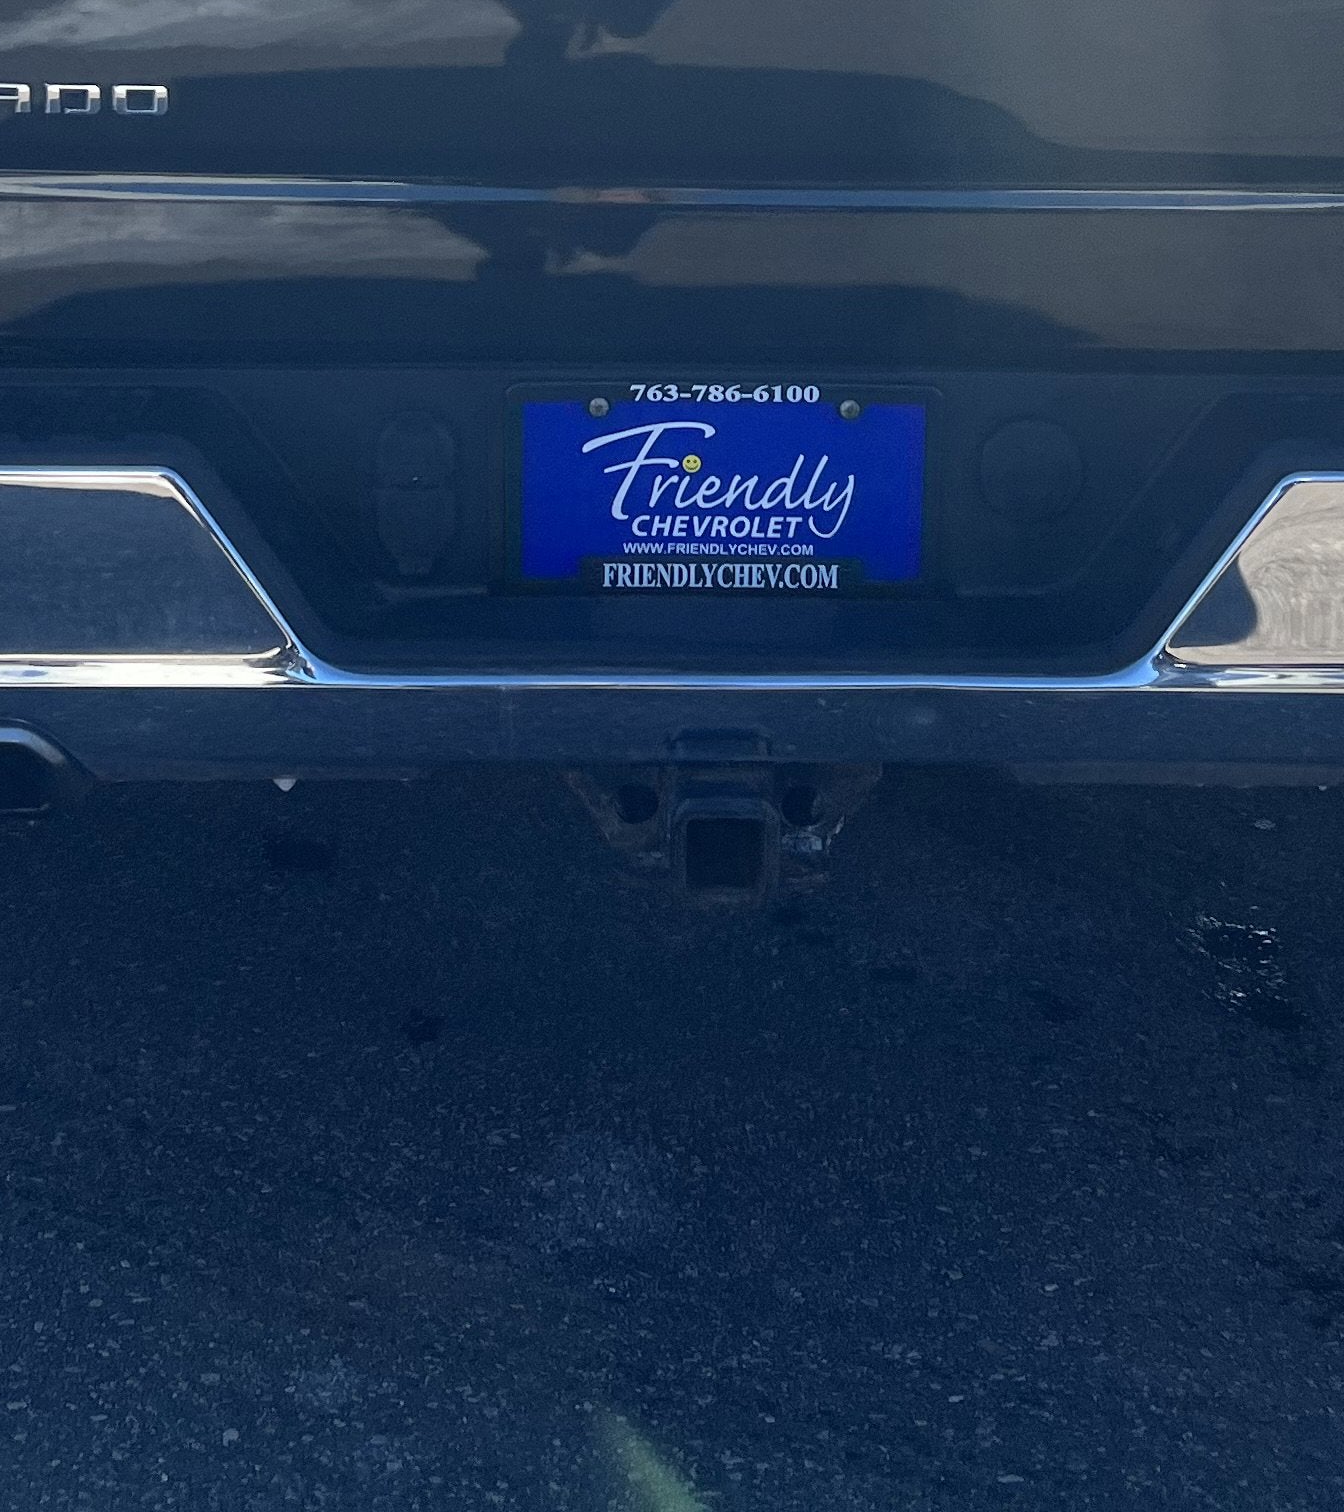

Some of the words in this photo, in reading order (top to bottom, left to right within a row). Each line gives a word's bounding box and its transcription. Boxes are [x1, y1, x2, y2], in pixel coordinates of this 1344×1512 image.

[629, 383, 820, 403] 763-786-6100
[581, 420, 855, 539] Friendly
[631, 514, 803, 539] CHEVROLET
[623, 541, 814, 557] WWW.FRIENDLYCHEV.COM
[602, 562, 839, 589] FRIENDLYCHEV.COM
